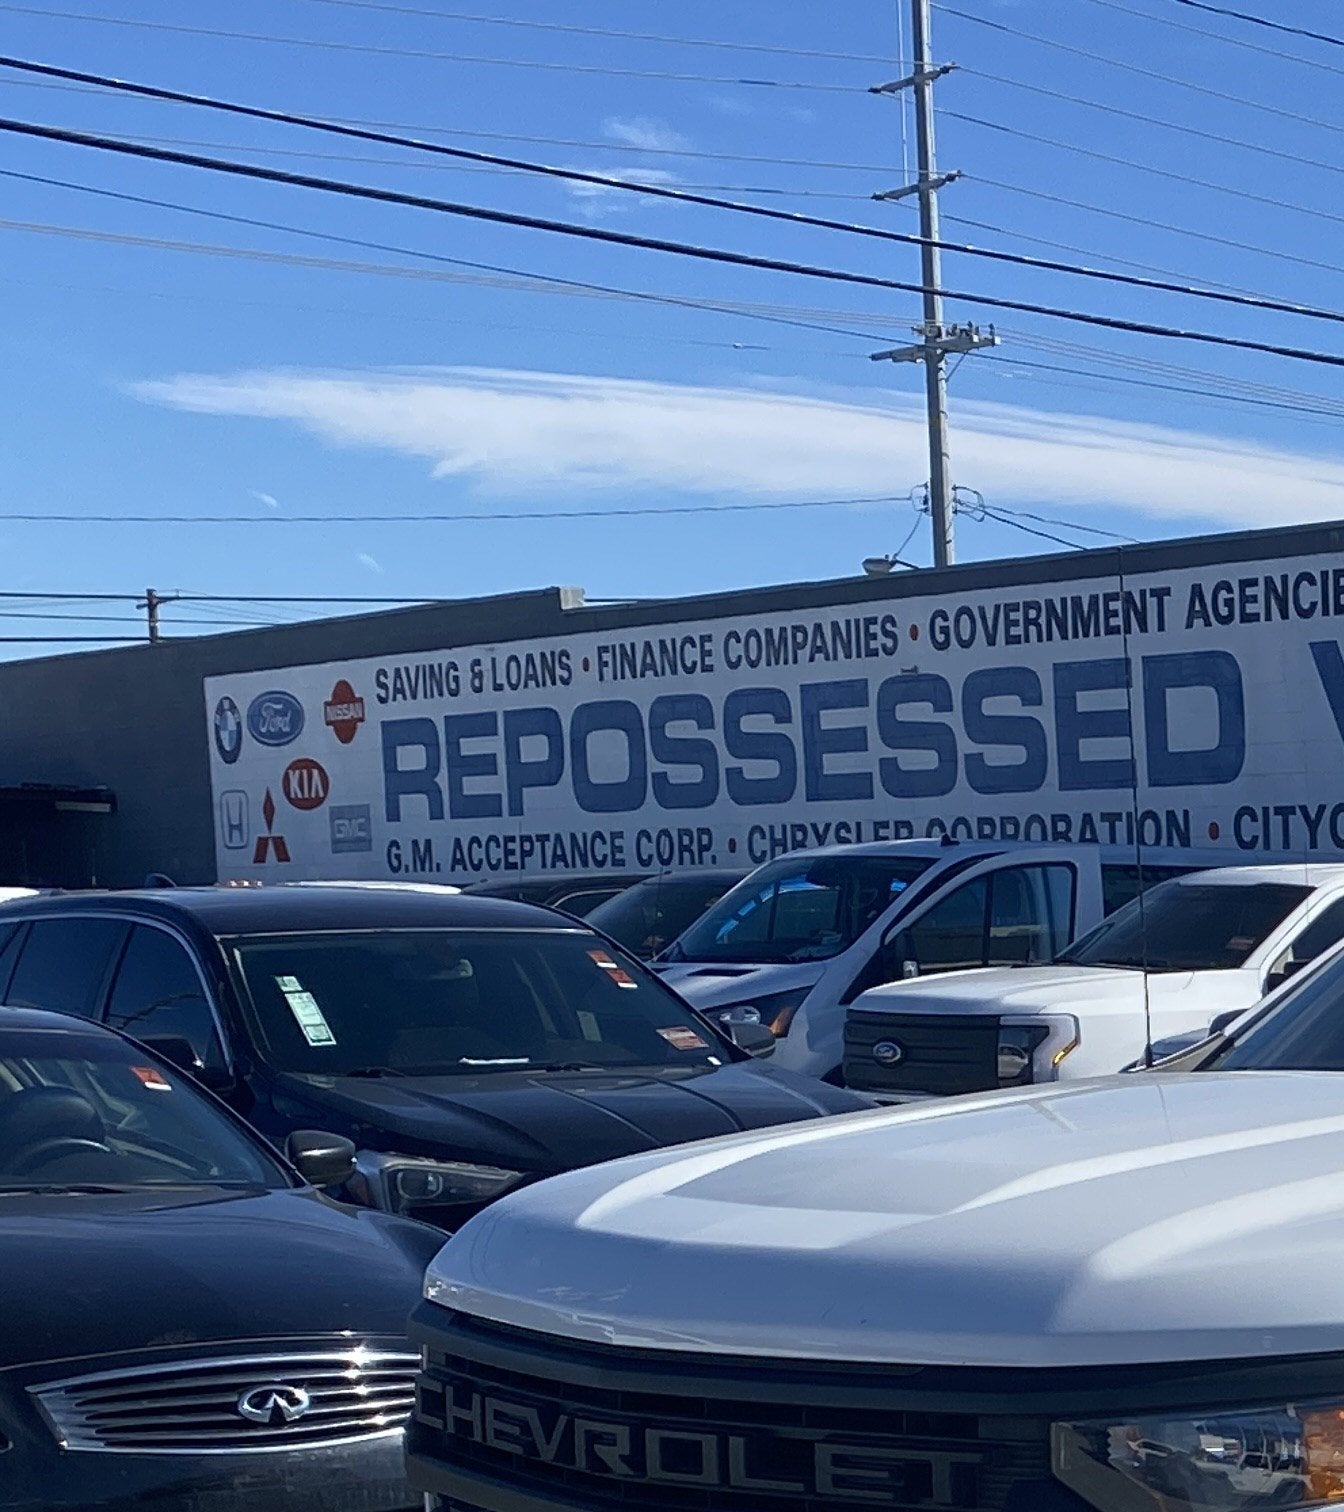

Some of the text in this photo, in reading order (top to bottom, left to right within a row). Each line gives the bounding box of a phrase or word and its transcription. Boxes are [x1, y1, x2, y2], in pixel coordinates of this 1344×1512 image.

[375, 665, 461, 704] SAVING
[470, 664, 484, 692] &
[491, 650, 573, 692] LOANS
[597, 632, 715, 682] FINANCE
[723, 615, 899, 670] COMPANIES
[929, 586, 1171, 651] GOVERNMENT
[287, 769, 325, 799] KIA
[380, 650, 1245, 823] REPOSSESSED
[386, 840, 442, 874] G.M.
[452, 830, 626, 873] ACCEPTANCE
[636, 827, 717, 869] CORP.
[415, 1378, 983, 1503] CHEVROLET
